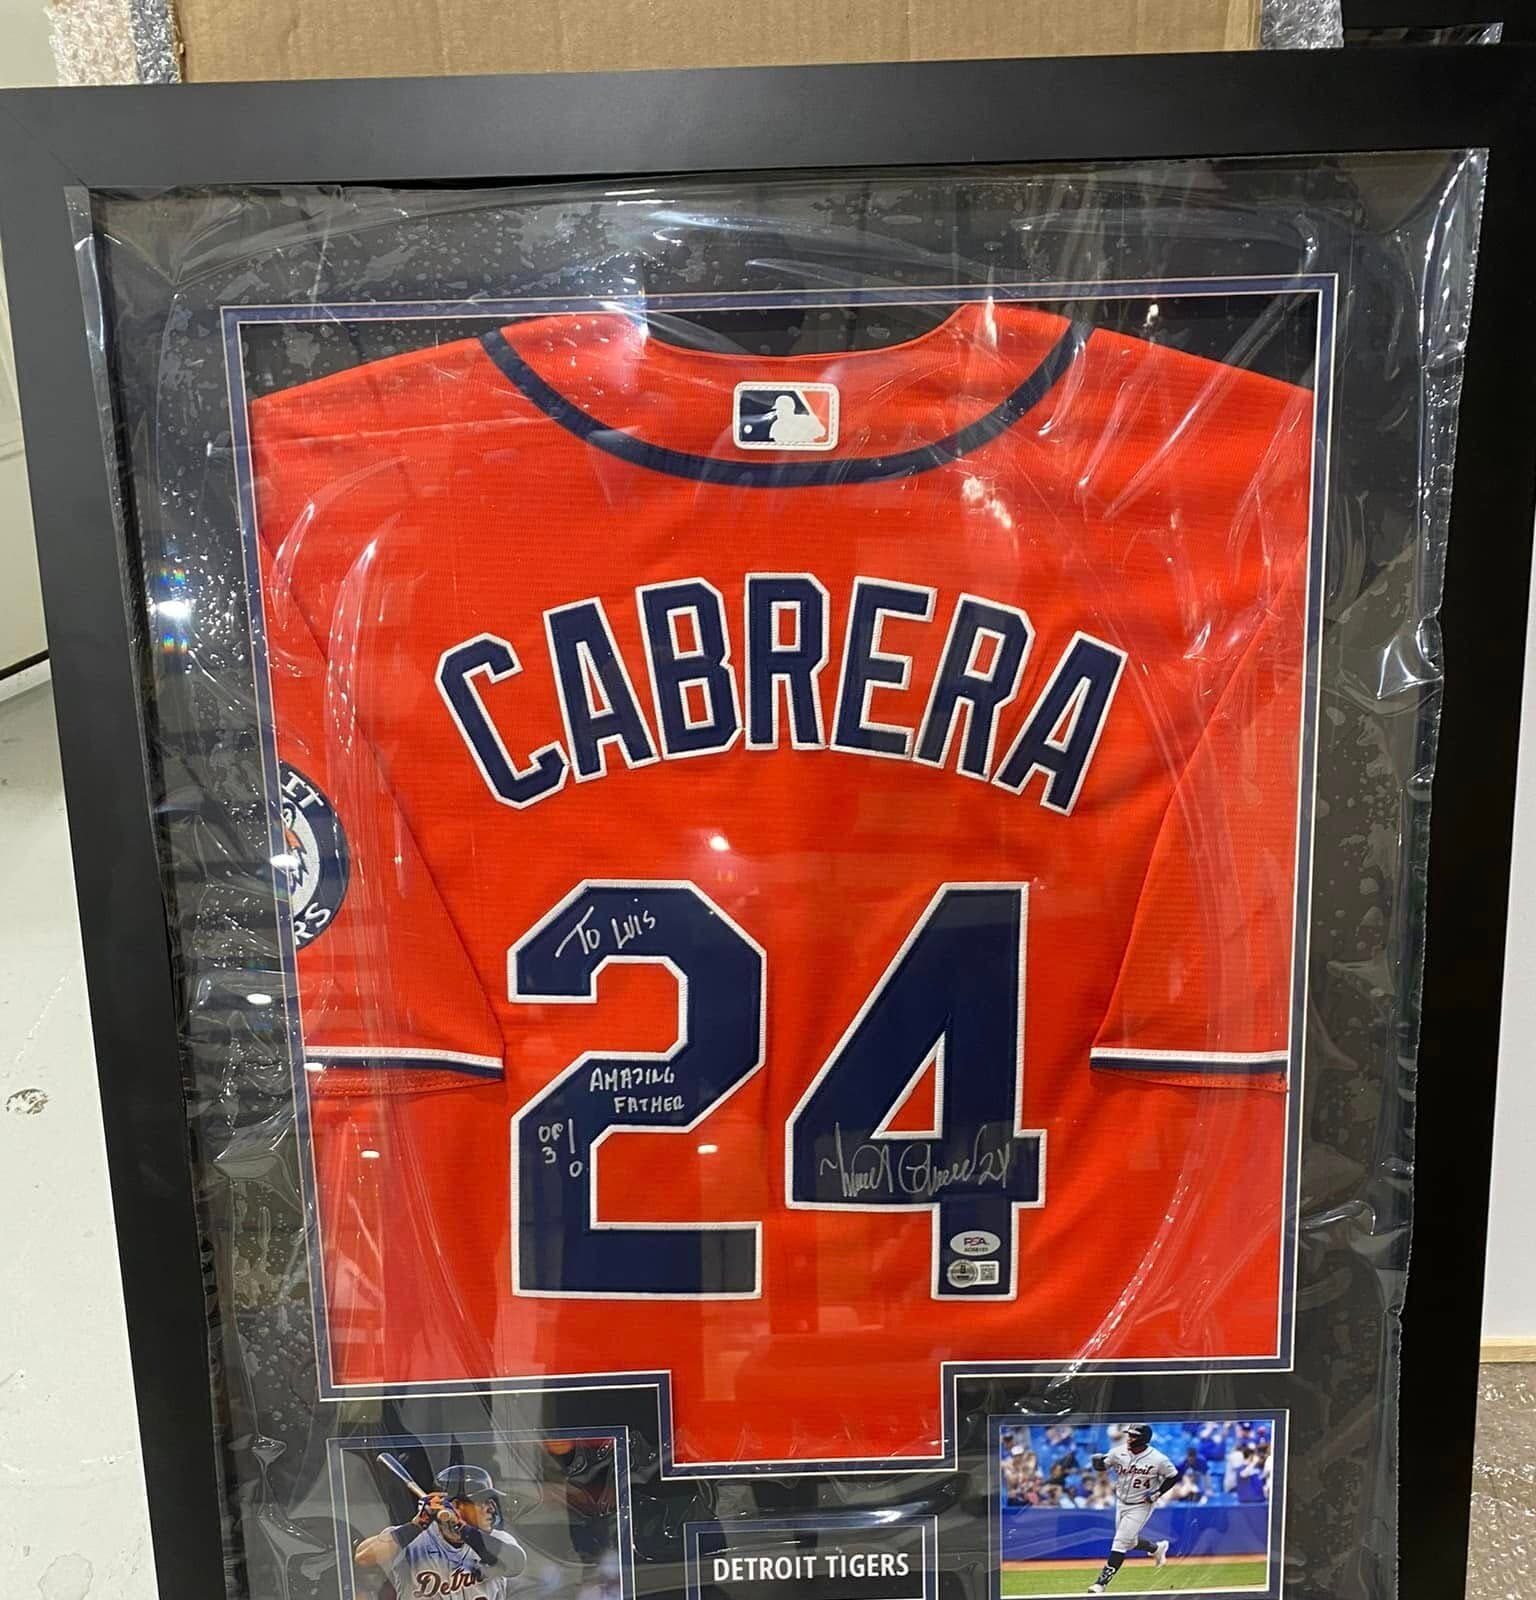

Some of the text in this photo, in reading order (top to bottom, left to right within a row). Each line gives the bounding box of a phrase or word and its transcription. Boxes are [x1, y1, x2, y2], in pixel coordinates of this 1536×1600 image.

[434, 571, 1129, 817] CABRERA
[507, 878, 1047, 1301] 24
[613, 1095, 686, 1115] FATHER
[963, 1236, 989, 1247] PSA
[1132, 1478, 1151, 1489] 24
[712, 1552, 910, 1582] DETROIT TIGERS
